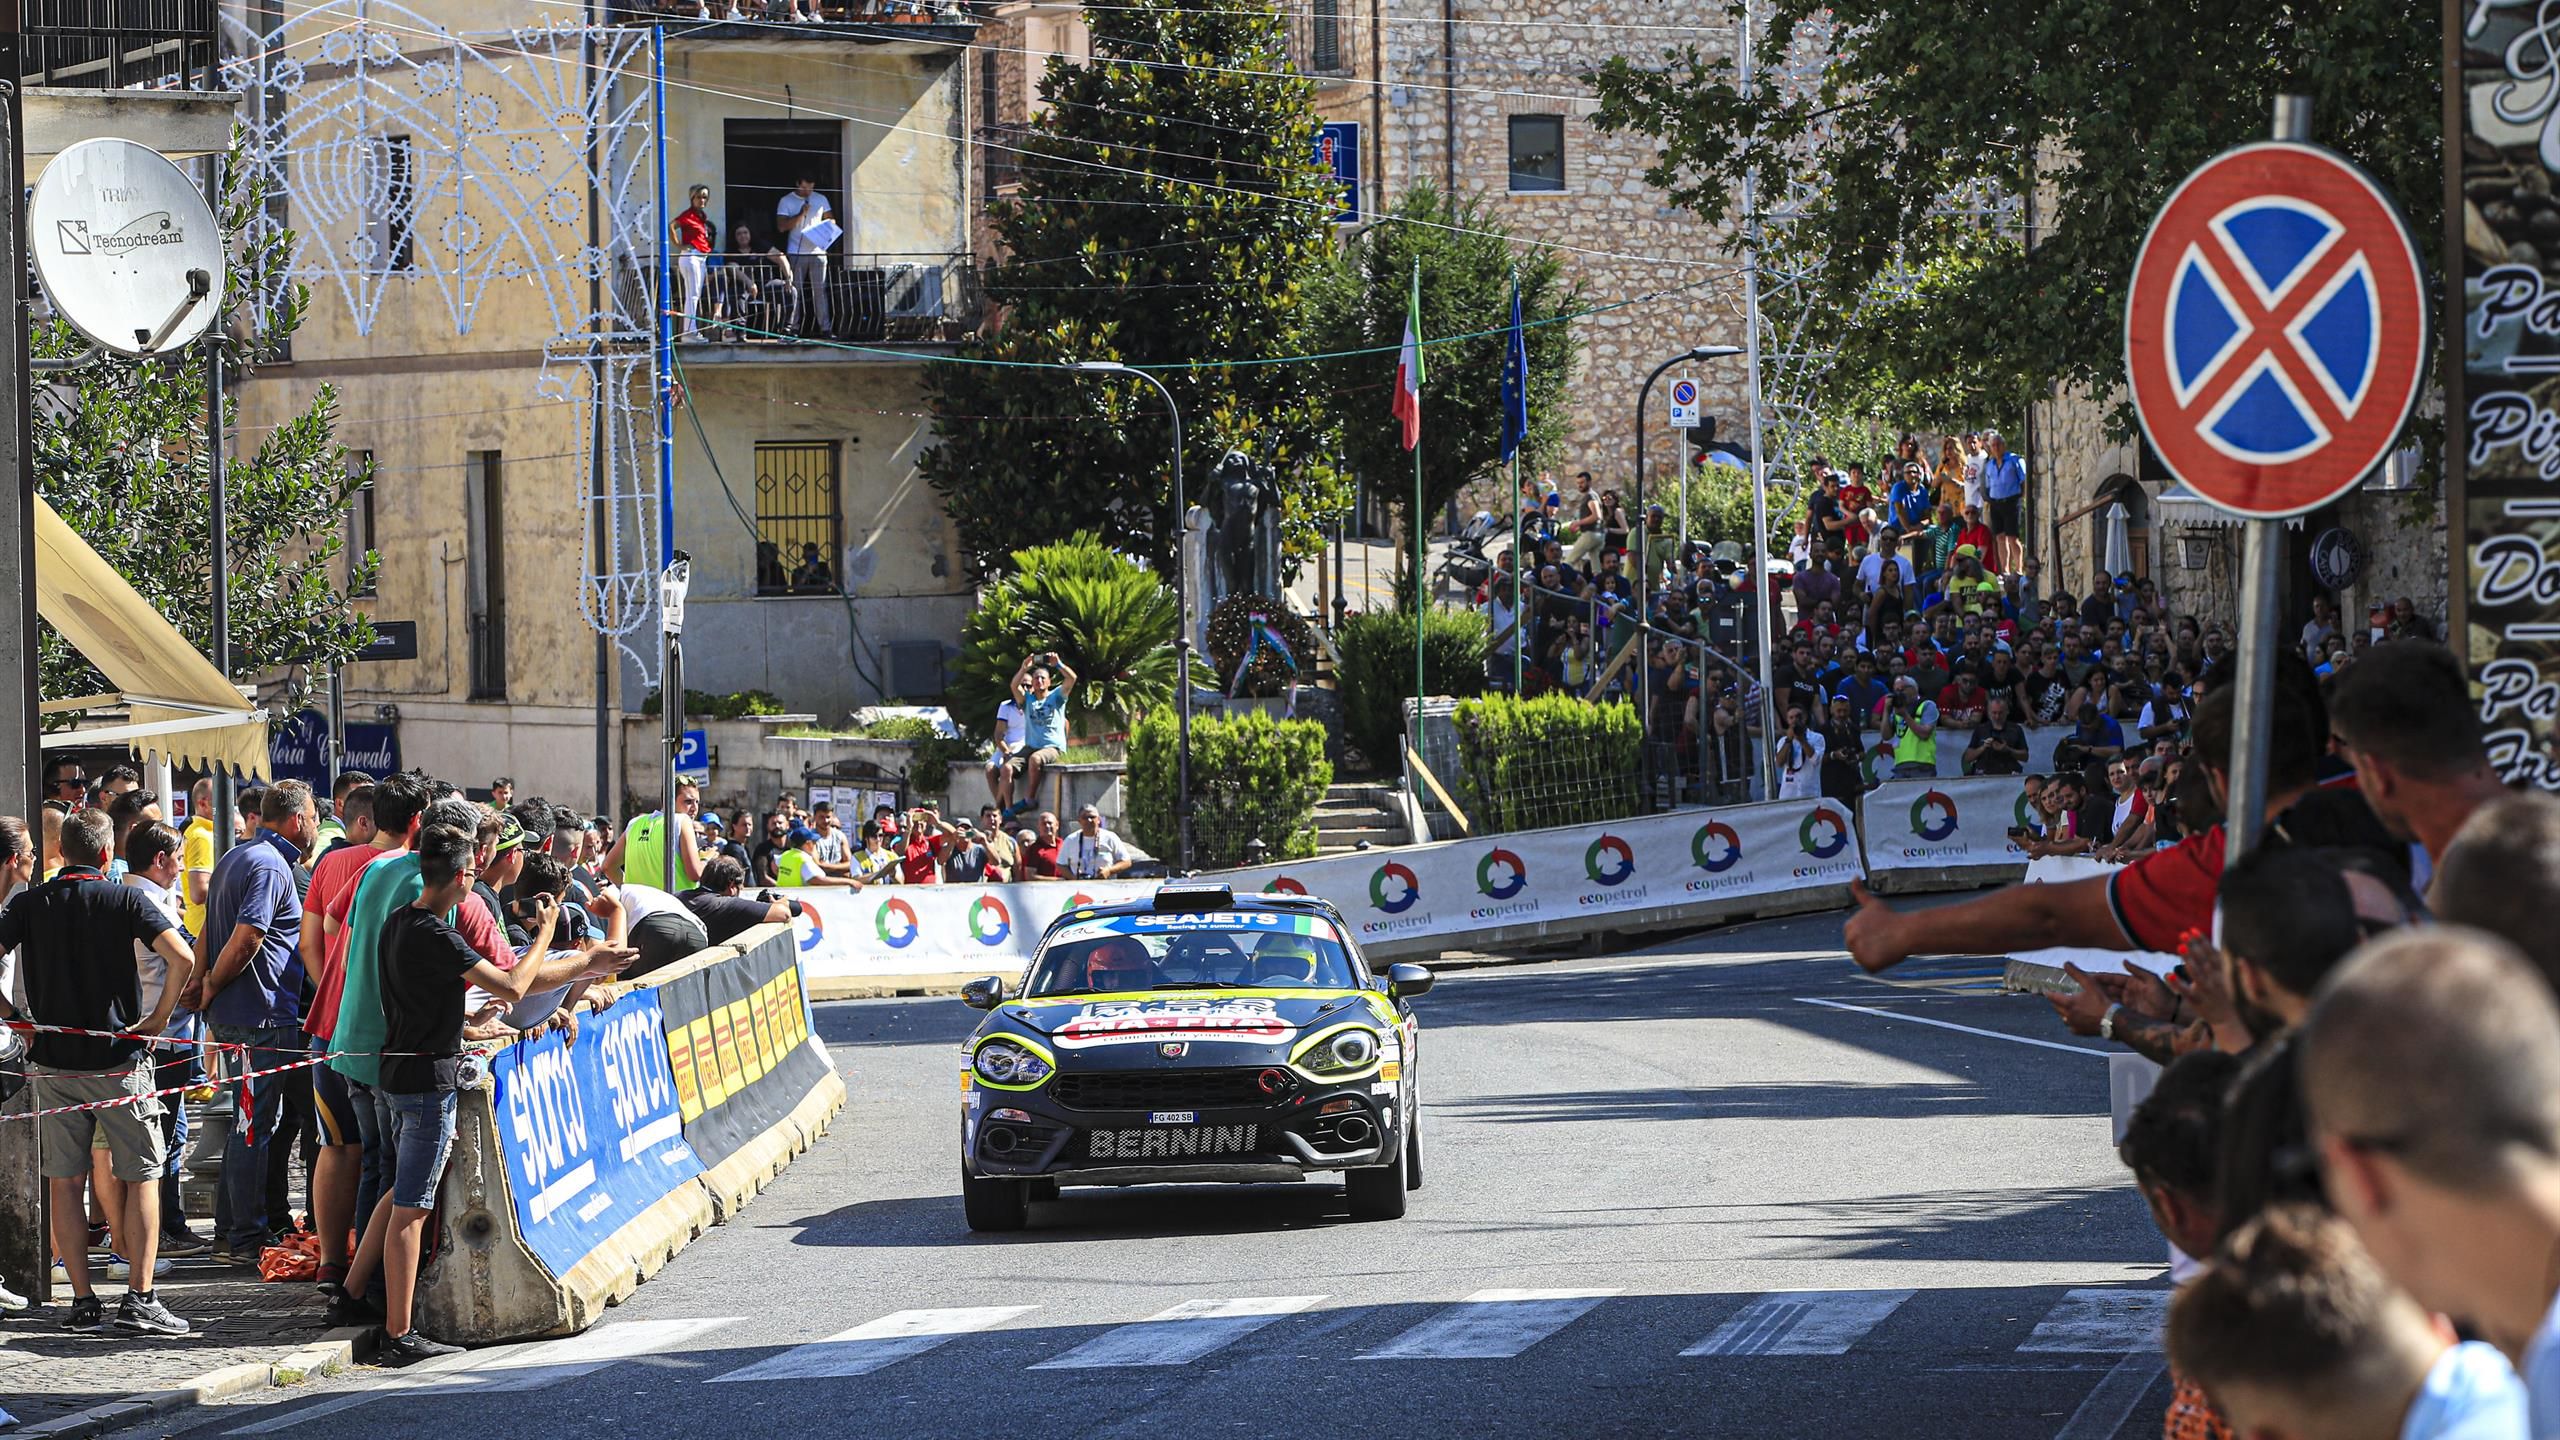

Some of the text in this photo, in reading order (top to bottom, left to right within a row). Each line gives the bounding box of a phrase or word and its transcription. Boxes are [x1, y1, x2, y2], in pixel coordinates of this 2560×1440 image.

[93, 231, 184, 249] Tecnodream
[317, 733, 391, 769] Cnevale
[679, 738, 698, 765] P
[1903, 843, 1968, 859] ecopetrol
[1686, 871, 1754, 892] ecopetrol
[1579, 885, 1648, 906] ecopetrol
[1134, 912, 1278, 926] SEAJETS
[1471, 899, 1539, 919] ecopetrol
[1363, 912, 1432, 933] ecopetrol
[601, 1009, 670, 1167] sparco
[1154, 1113, 1193, 1121] FG 402 SB
[507, 1042, 588, 1225] sparco
[1089, 1124, 1258, 1159] BERNINI
